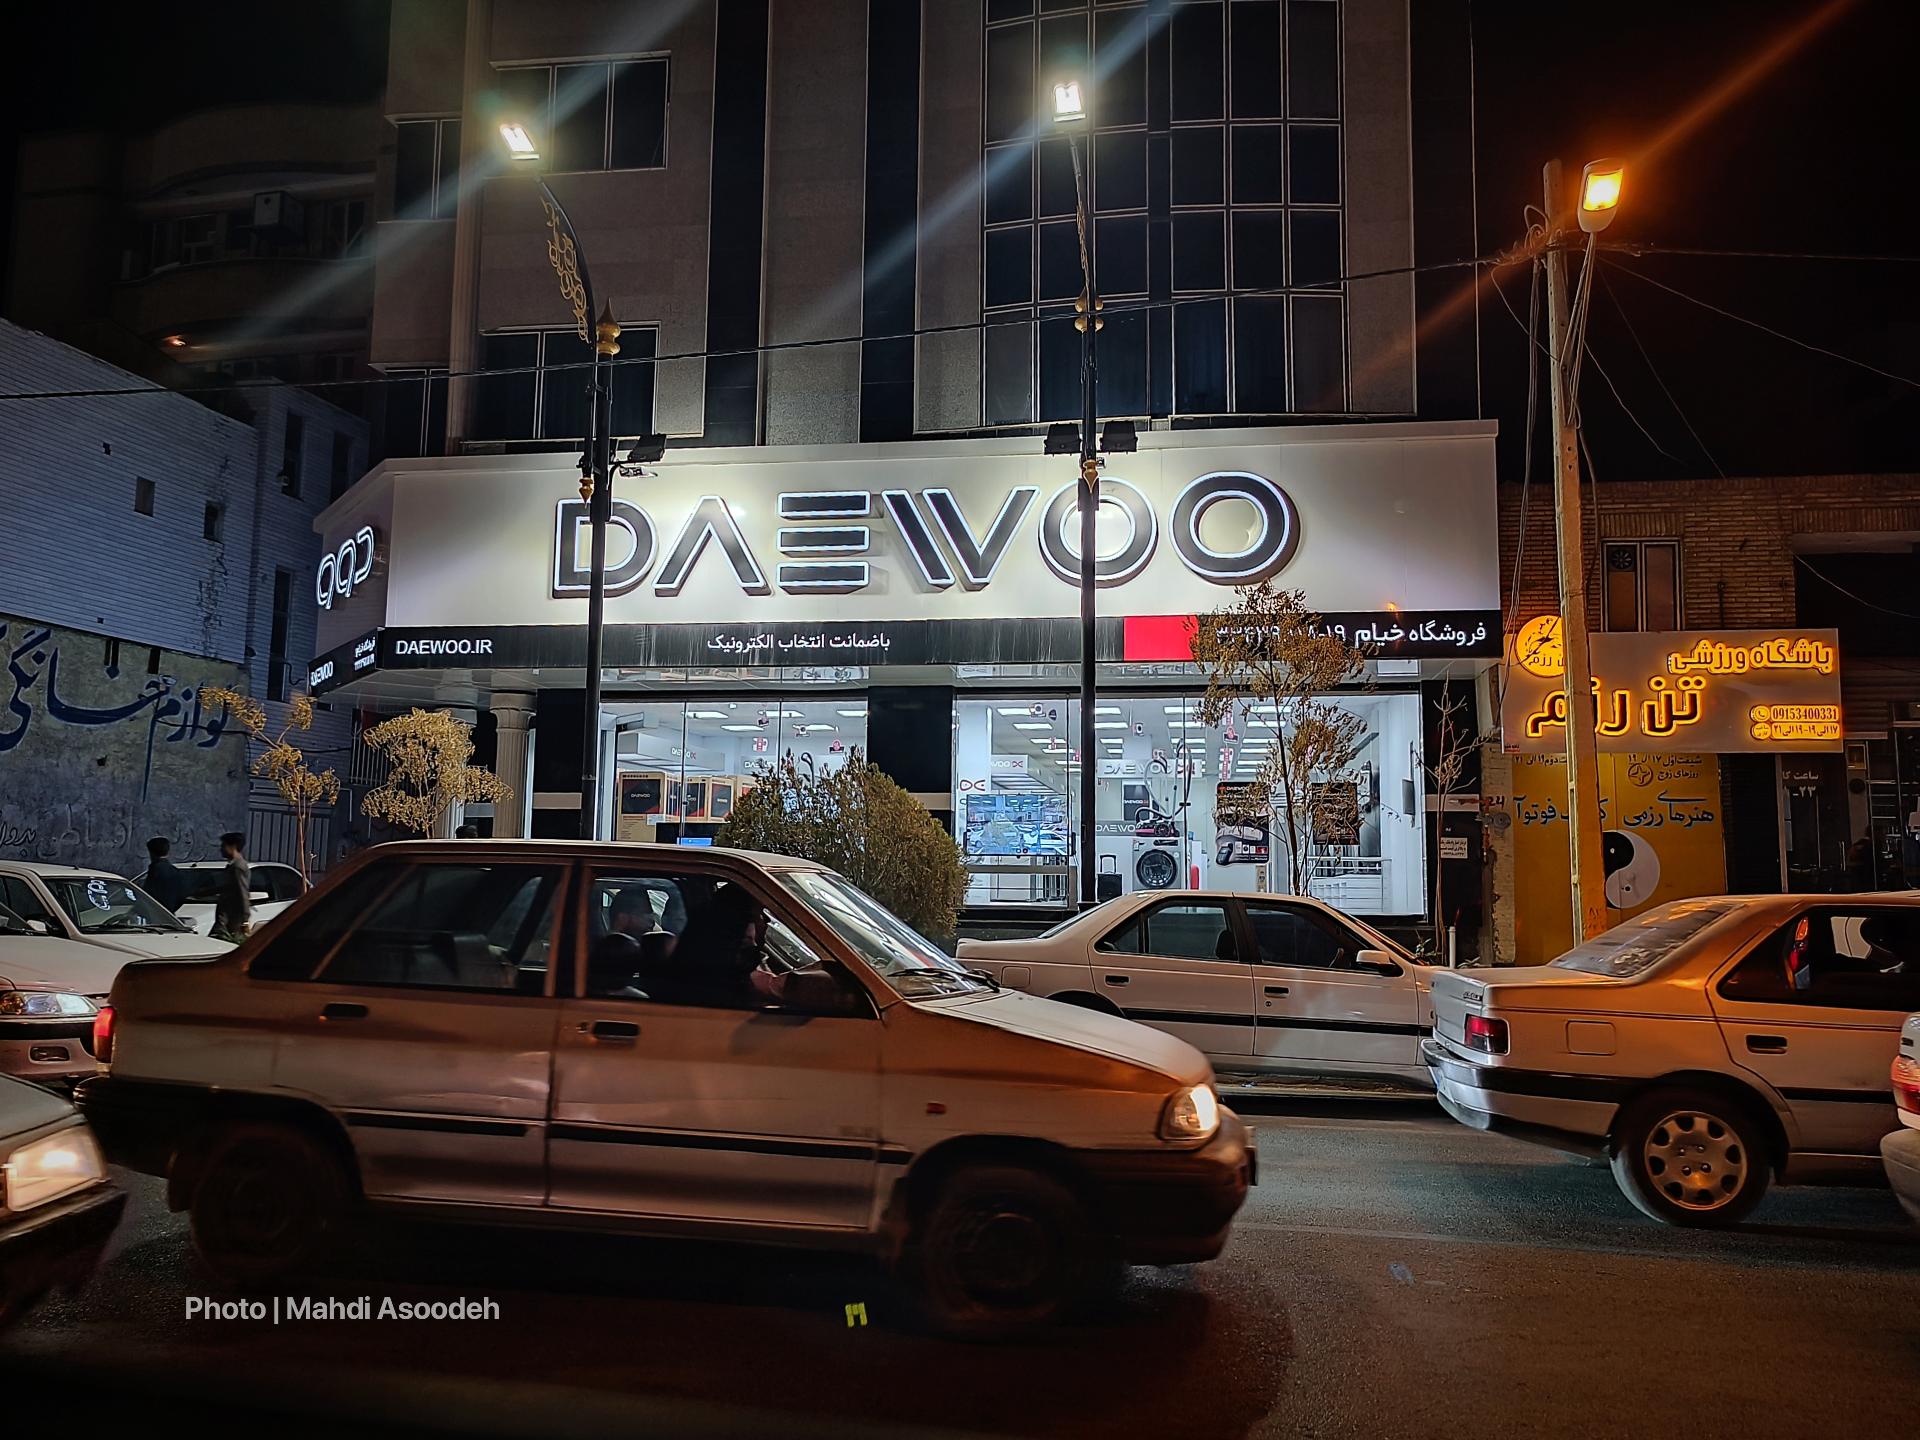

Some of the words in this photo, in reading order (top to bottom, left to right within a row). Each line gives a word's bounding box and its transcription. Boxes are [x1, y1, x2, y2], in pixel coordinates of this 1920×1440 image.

[553, 471, 1298, 600] DAEWOO
[707, 633, 774, 653] الکترونیک
[778, 633, 825, 652] انتخاب
[829, 633, 891, 651] باضمانت
[1354, 622, 1404, 648] خیام
[1408, 619, 1487, 647] فروشگاه
[395, 639, 493, 655] DAEWOO.IR
[1670, 639, 1749, 673] ورزشی
[1751, 638, 1833, 673] باشگاه
[1642, 675, 1706, 737] تن
[1772, 707, 1838, 721] 09153400331
[1793, 770, 1819, 780] ساعت
[1623, 804, 1664, 827] رزمی
[1095, 824, 1136, 833] DAEWO
